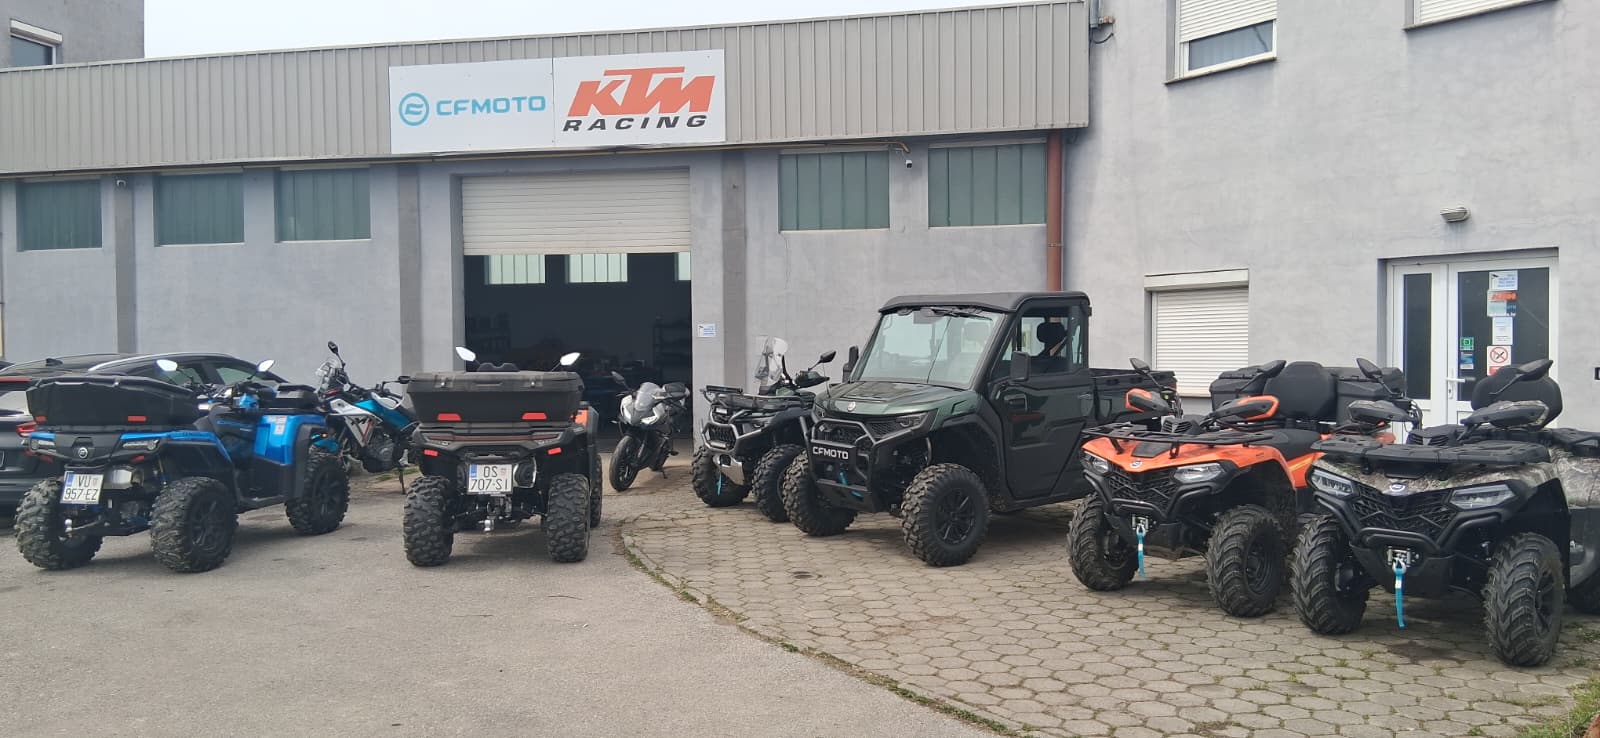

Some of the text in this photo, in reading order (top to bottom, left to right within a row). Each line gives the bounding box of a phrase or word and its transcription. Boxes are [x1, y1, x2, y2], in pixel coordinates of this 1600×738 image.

[567, 66, 716, 117] KTM
[436, 95, 546, 116] CFMOTO
[562, 114, 707, 132] RACING
[812, 446, 849, 459] CFMOTO
[483, 466, 498, 478] OS
[78, 475, 91, 487] VU
